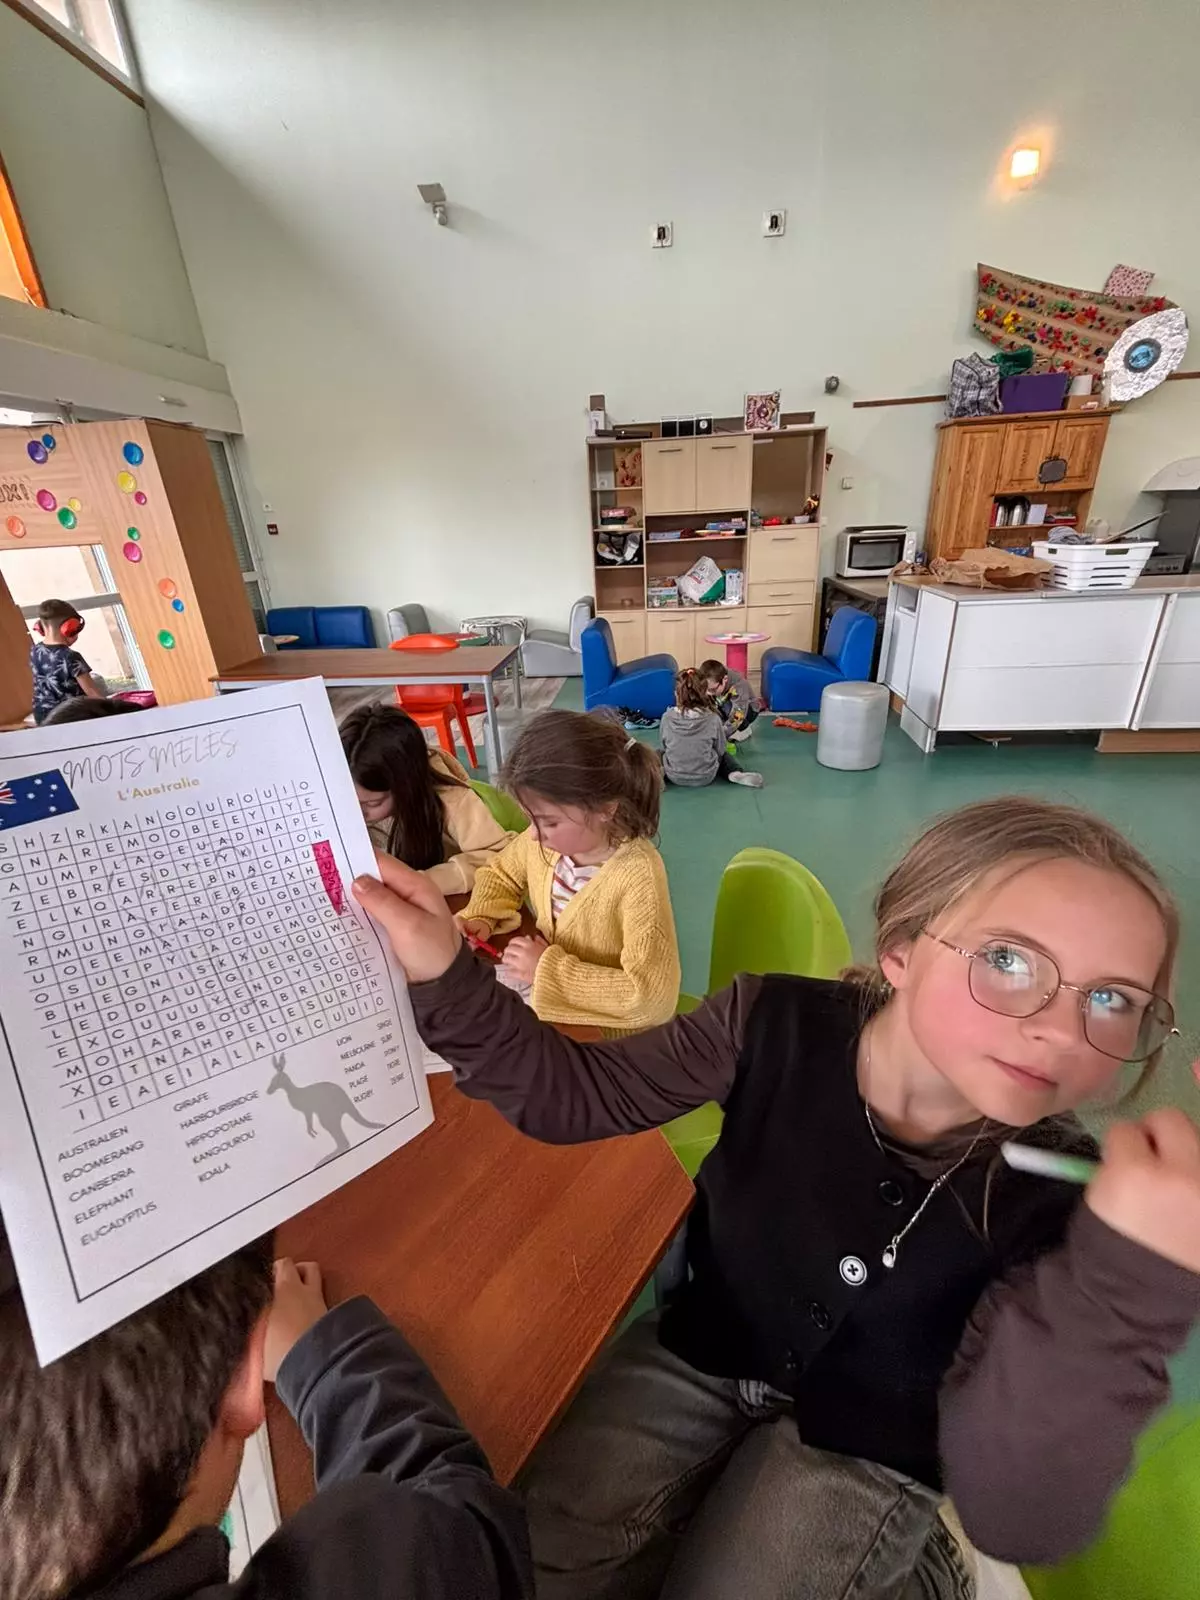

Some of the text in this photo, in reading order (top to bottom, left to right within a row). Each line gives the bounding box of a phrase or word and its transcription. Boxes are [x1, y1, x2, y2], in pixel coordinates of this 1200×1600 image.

[63, 745, 145, 789] MOTS
[117, 777, 200, 801] L'Australie
[173, 1091, 210, 1112] GIRAFE
[179, 1090, 259, 1130] HARBOURBRIDGE
[57, 1126, 128, 1162] AUSTRALIEN
[185, 1112, 253, 1148] HIPPOPOTAME
[192, 1130, 256, 1164] KANGOUROU
[62, 1140, 144, 1183] BOOMERANG
[198, 1162, 231, 1183] KOALA
[69, 1167, 135, 1202] CANBERRA
[74, 1188, 135, 1225] ELEPHANT
[80, 1201, 158, 1246] EUCALYPTUS
